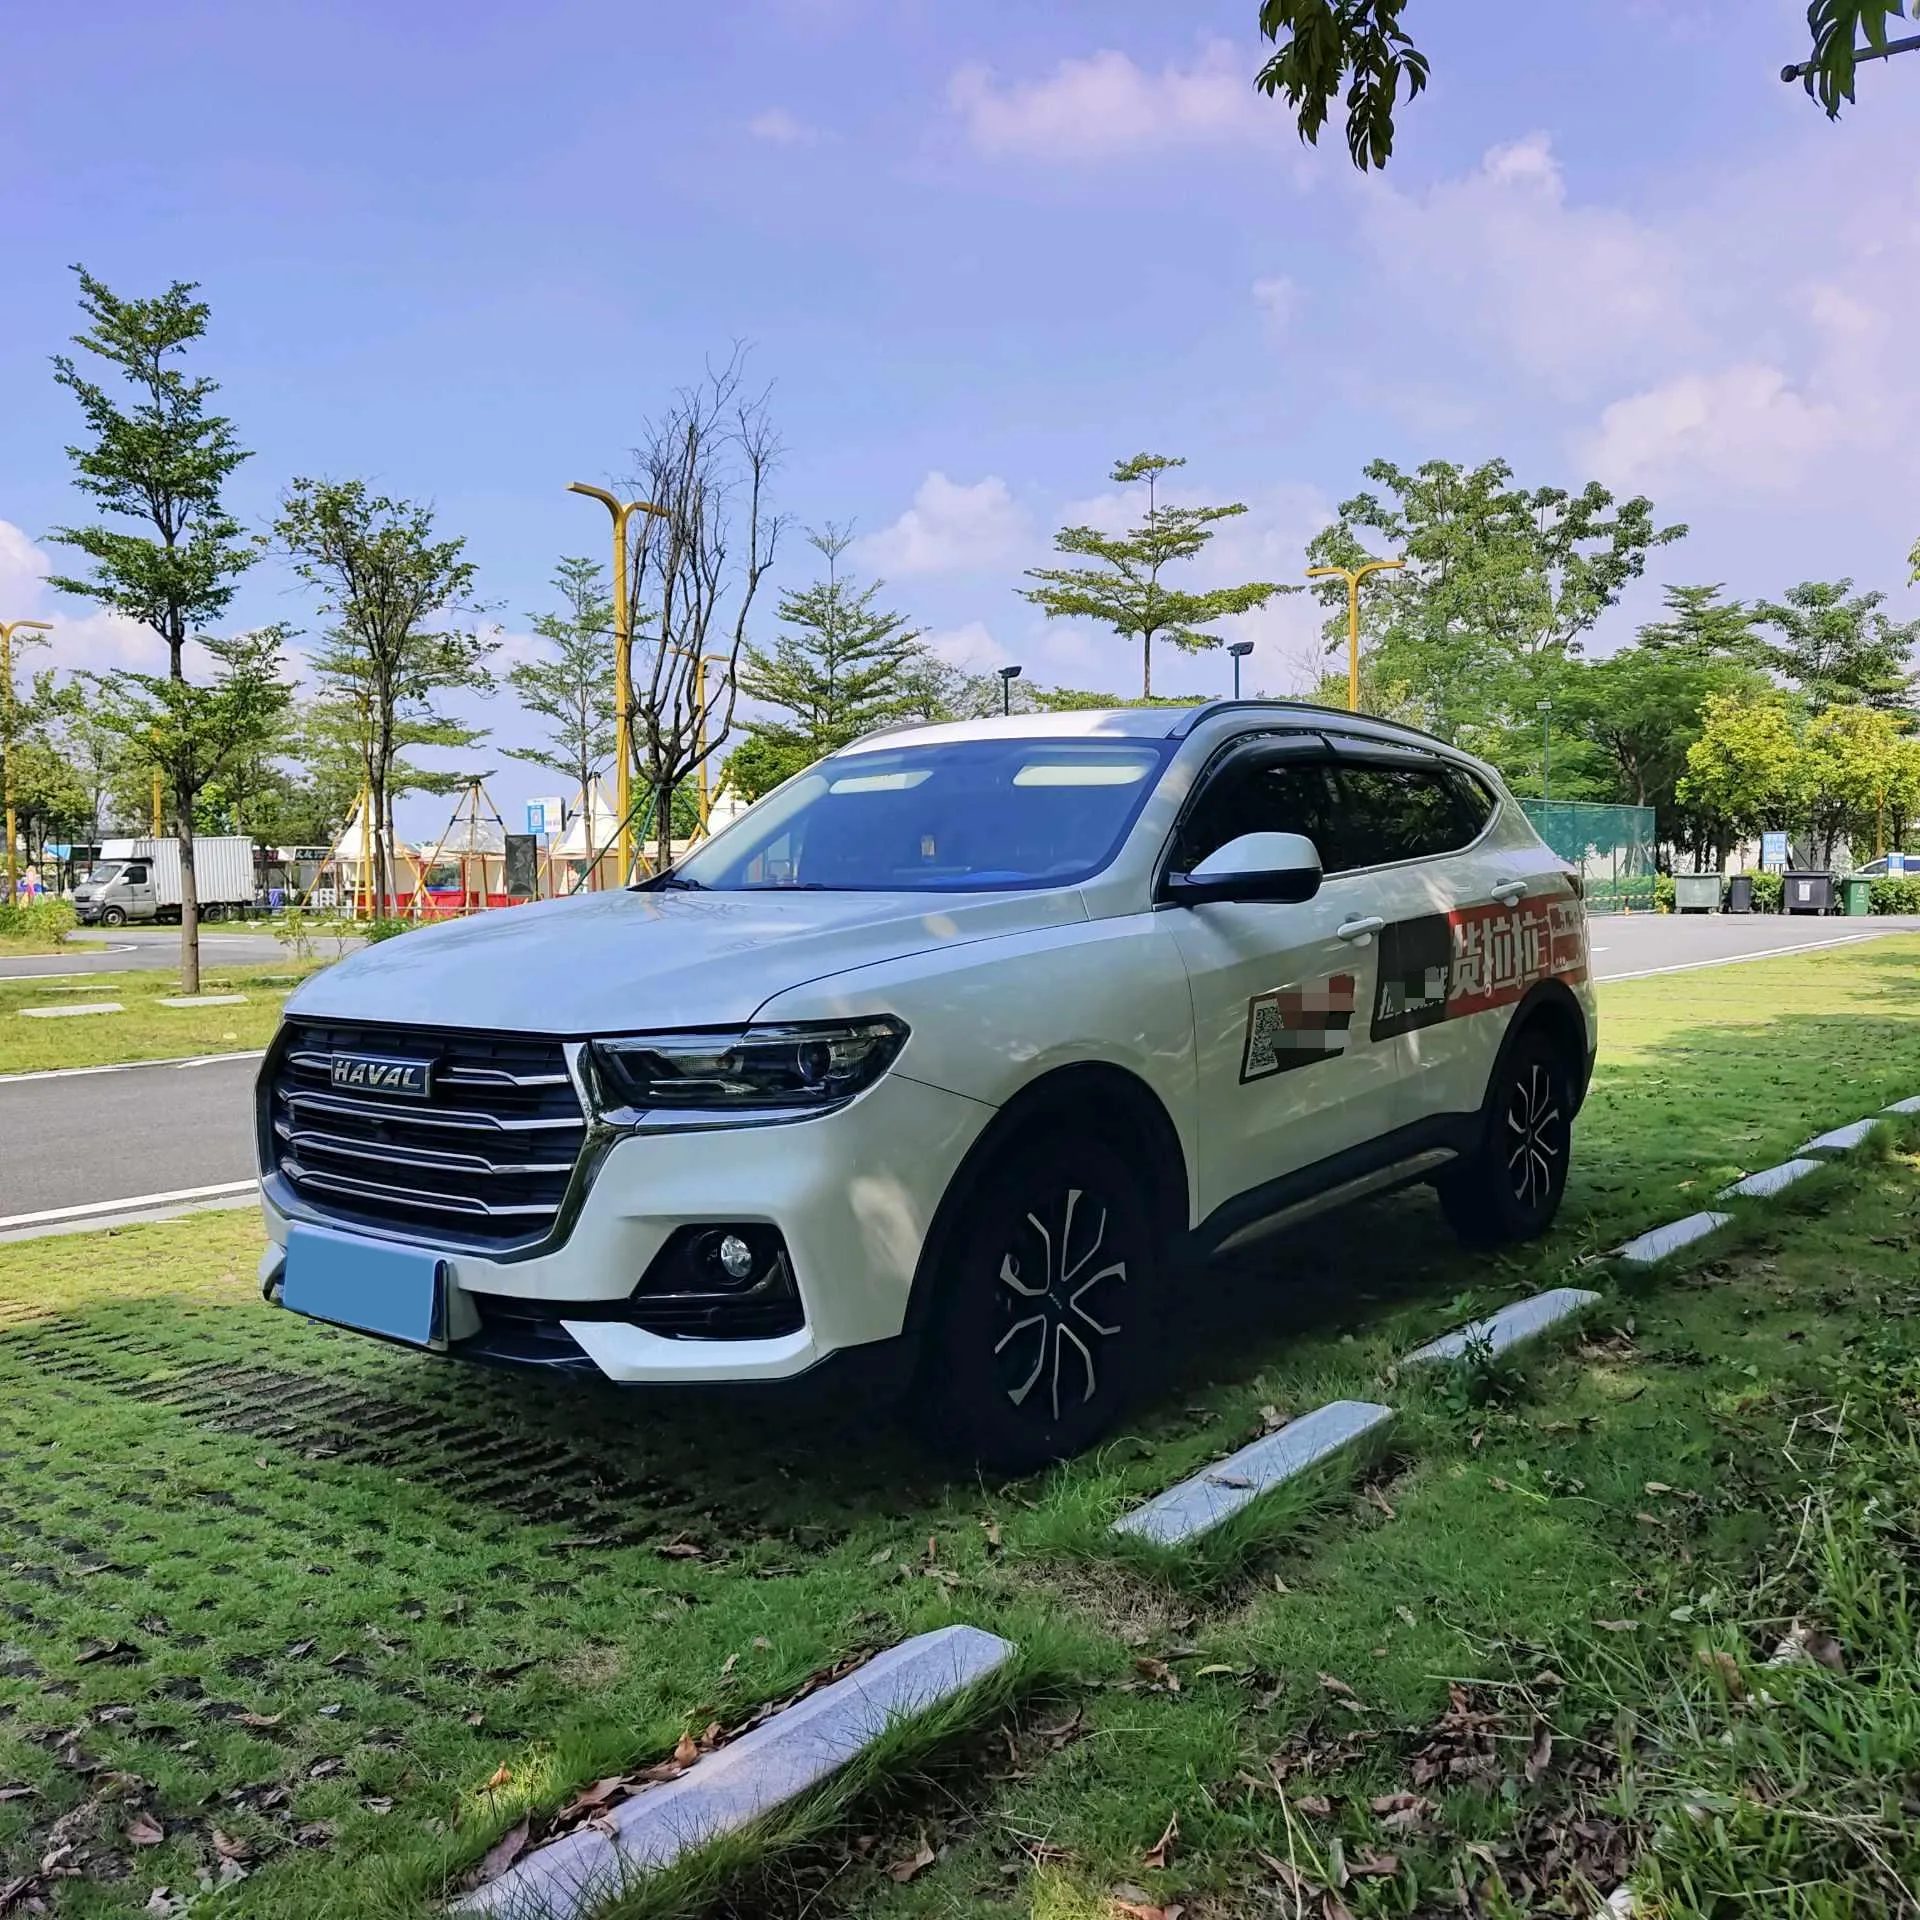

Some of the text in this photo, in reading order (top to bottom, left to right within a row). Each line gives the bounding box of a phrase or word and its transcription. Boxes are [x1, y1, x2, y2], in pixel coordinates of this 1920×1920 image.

[1450, 911, 1541, 1000] 货拉拉
[334, 1060, 421, 1089] HAVAL
